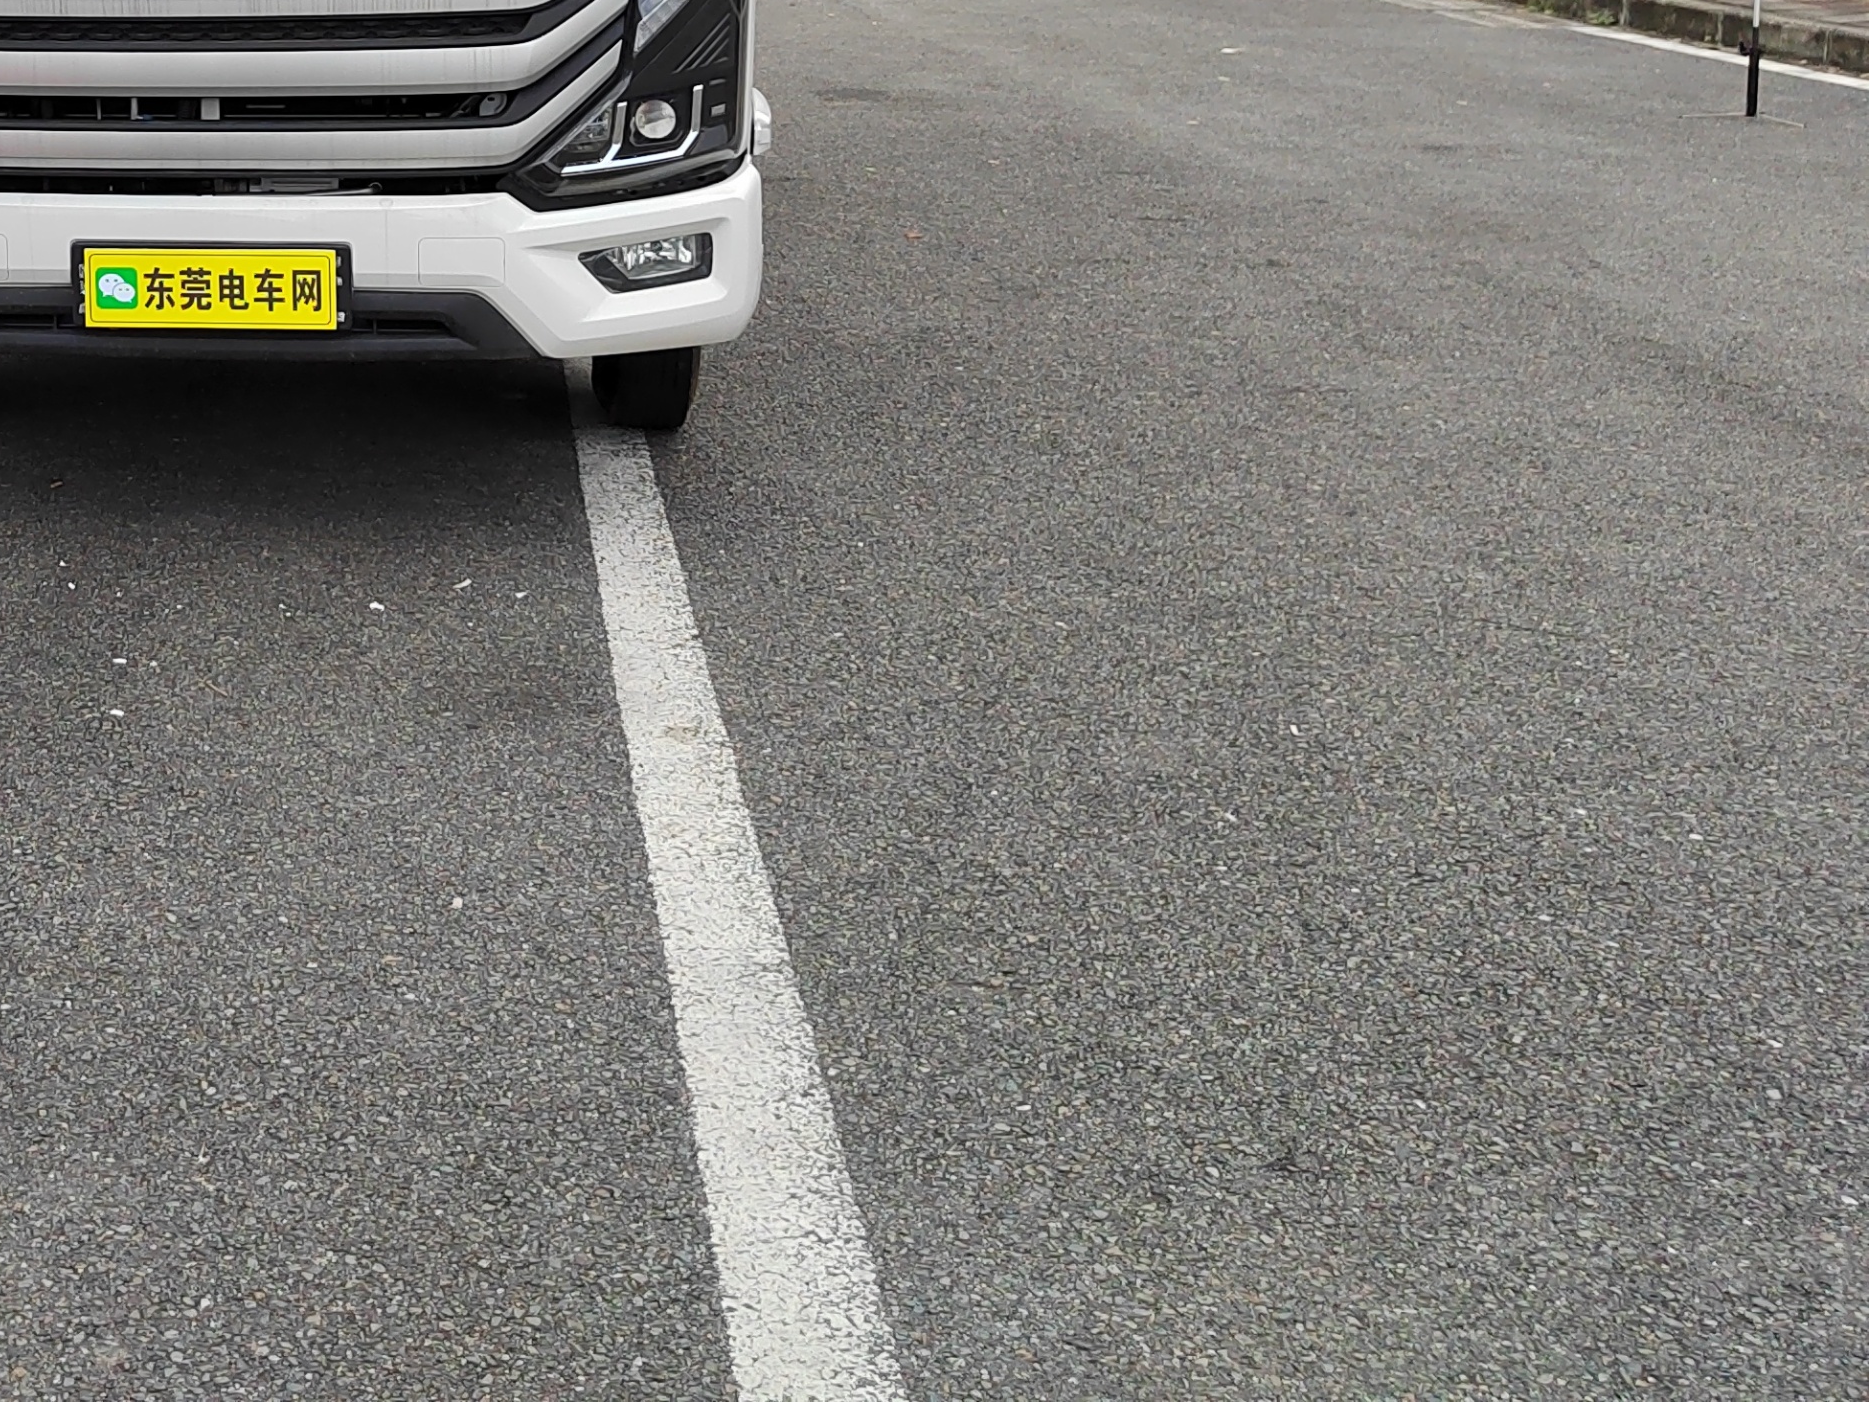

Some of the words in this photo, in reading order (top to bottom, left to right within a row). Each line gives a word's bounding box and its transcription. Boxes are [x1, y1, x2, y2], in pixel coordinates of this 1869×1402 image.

[143, 267, 322, 311] 东莞电车网
